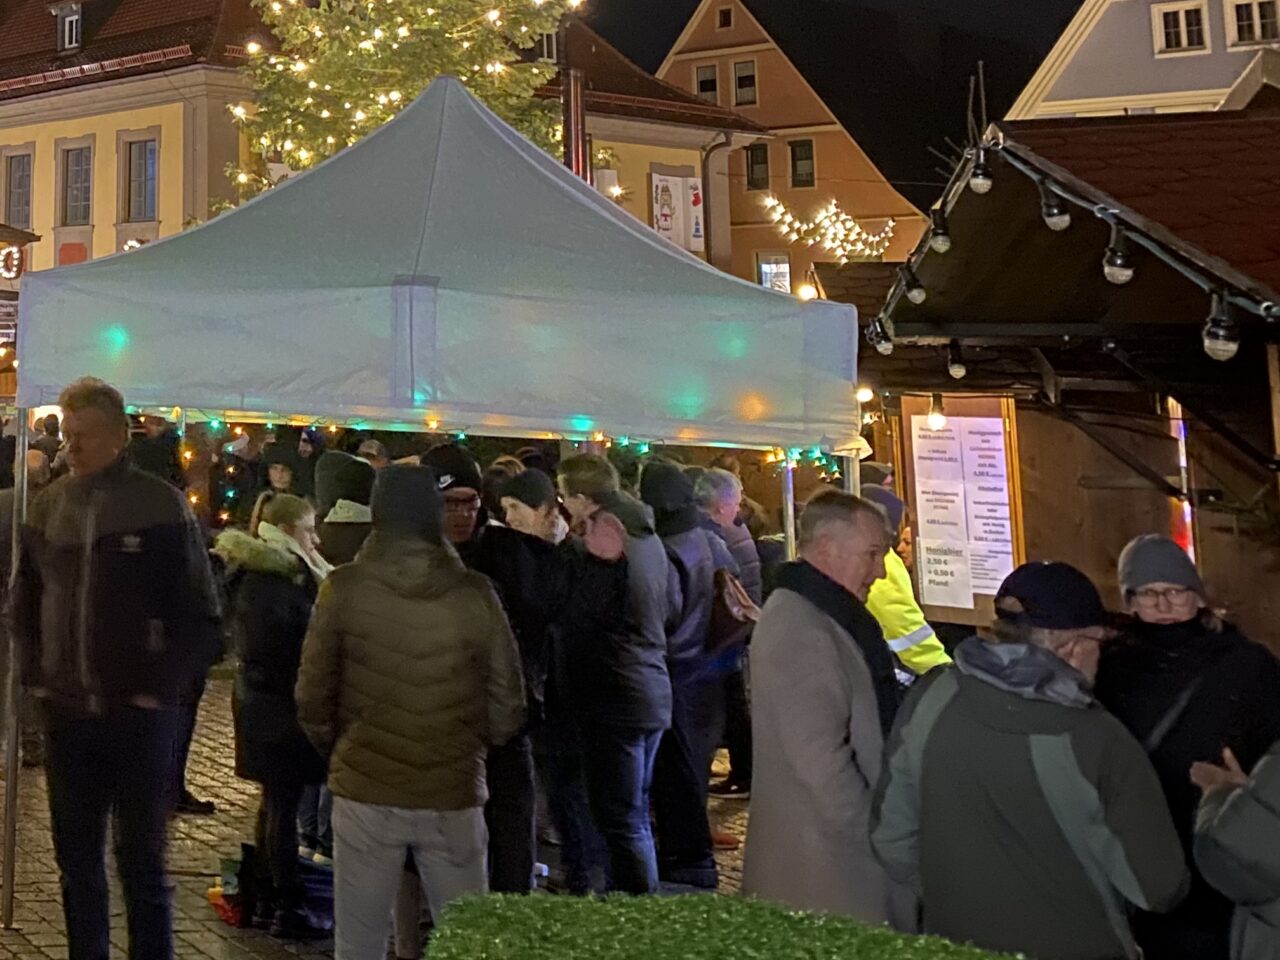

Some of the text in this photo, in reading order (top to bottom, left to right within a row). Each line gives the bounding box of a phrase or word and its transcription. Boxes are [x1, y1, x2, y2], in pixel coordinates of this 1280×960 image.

[925, 546, 963, 557] Honigbier
[927, 557, 942, 565] 2,50
[933, 569, 949, 577] 0,50
[928, 579, 949, 587] Pfand
